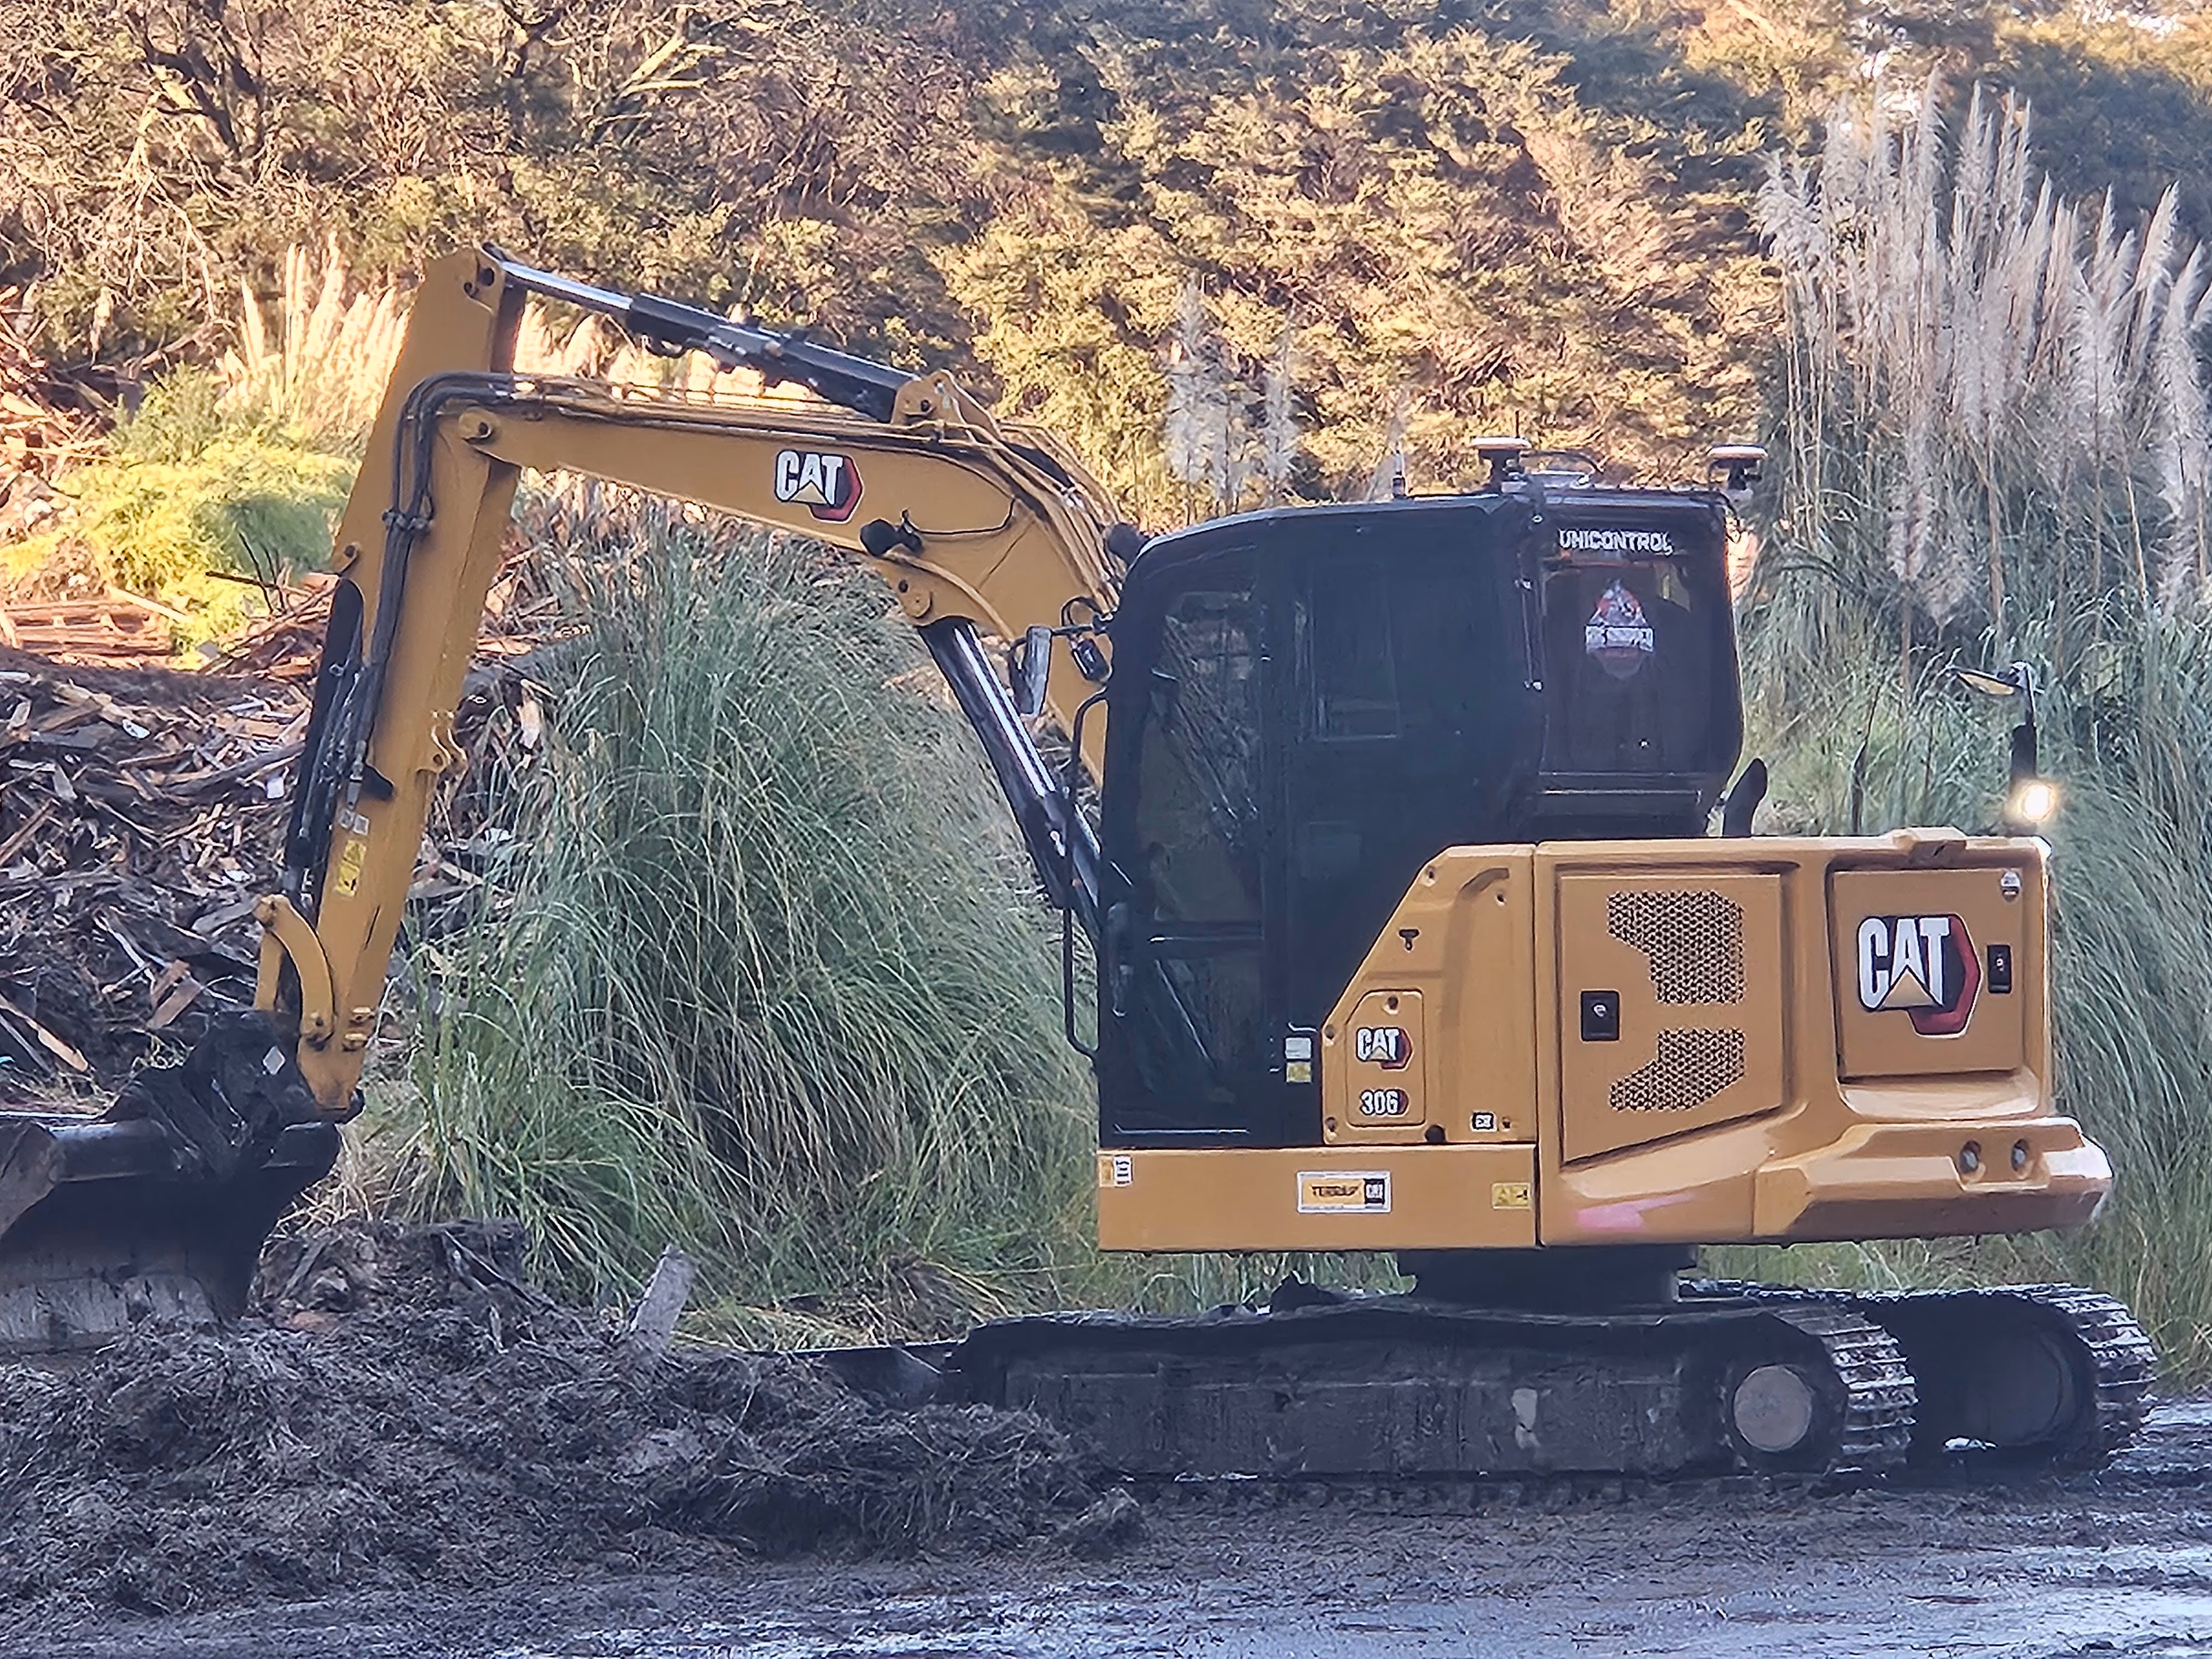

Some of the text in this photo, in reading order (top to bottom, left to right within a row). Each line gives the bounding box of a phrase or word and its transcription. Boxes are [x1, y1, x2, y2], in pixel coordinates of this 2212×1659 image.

[776, 450, 843, 505] CAT
[1558, 530, 1673, 555] UNICONTROL
[1858, 917, 1949, 1009] CAT
[1357, 1028, 1400, 1061] CAT
[1361, 1091, 1399, 1114] 306
